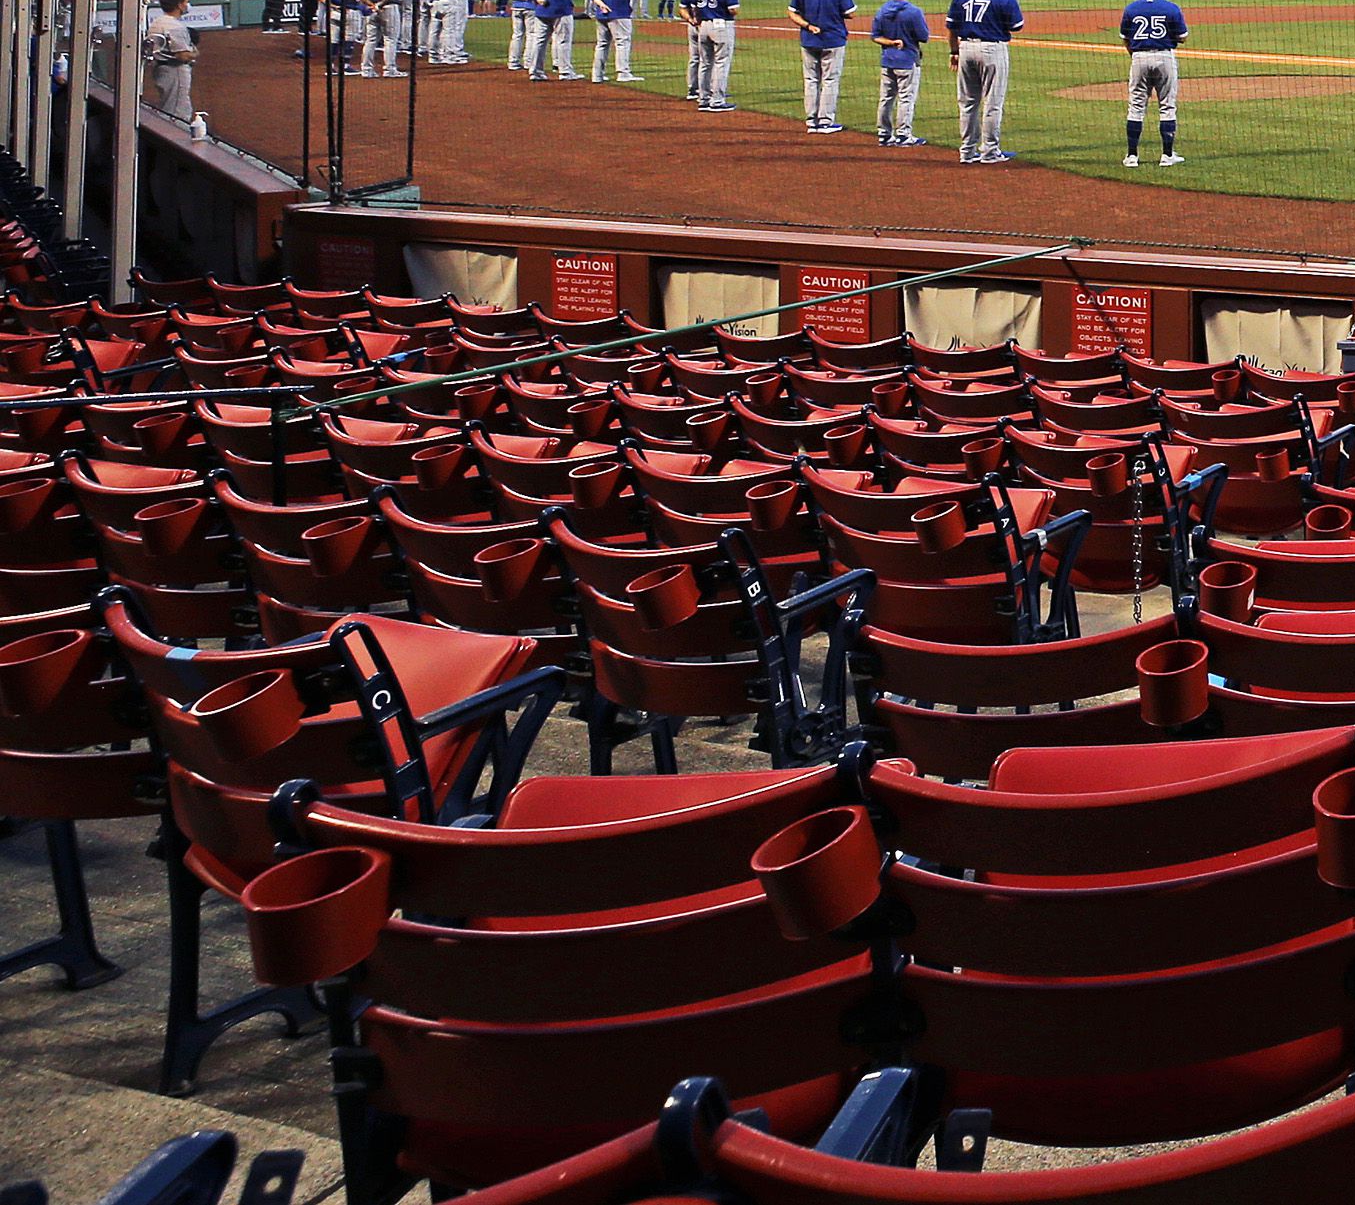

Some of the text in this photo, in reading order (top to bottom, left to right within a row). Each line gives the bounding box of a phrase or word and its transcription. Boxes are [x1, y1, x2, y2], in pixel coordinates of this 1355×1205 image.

[962, 0, 991, 23] 17
[1132, 15, 1167, 37] 25
[556, 259, 614, 272] CAUTION!
[802, 275, 866, 289] CAUTION!
[1076, 294, 1147, 309] CAUTION!
[747, 581, 761, 597] B
[372, 689, 391, 710] C
